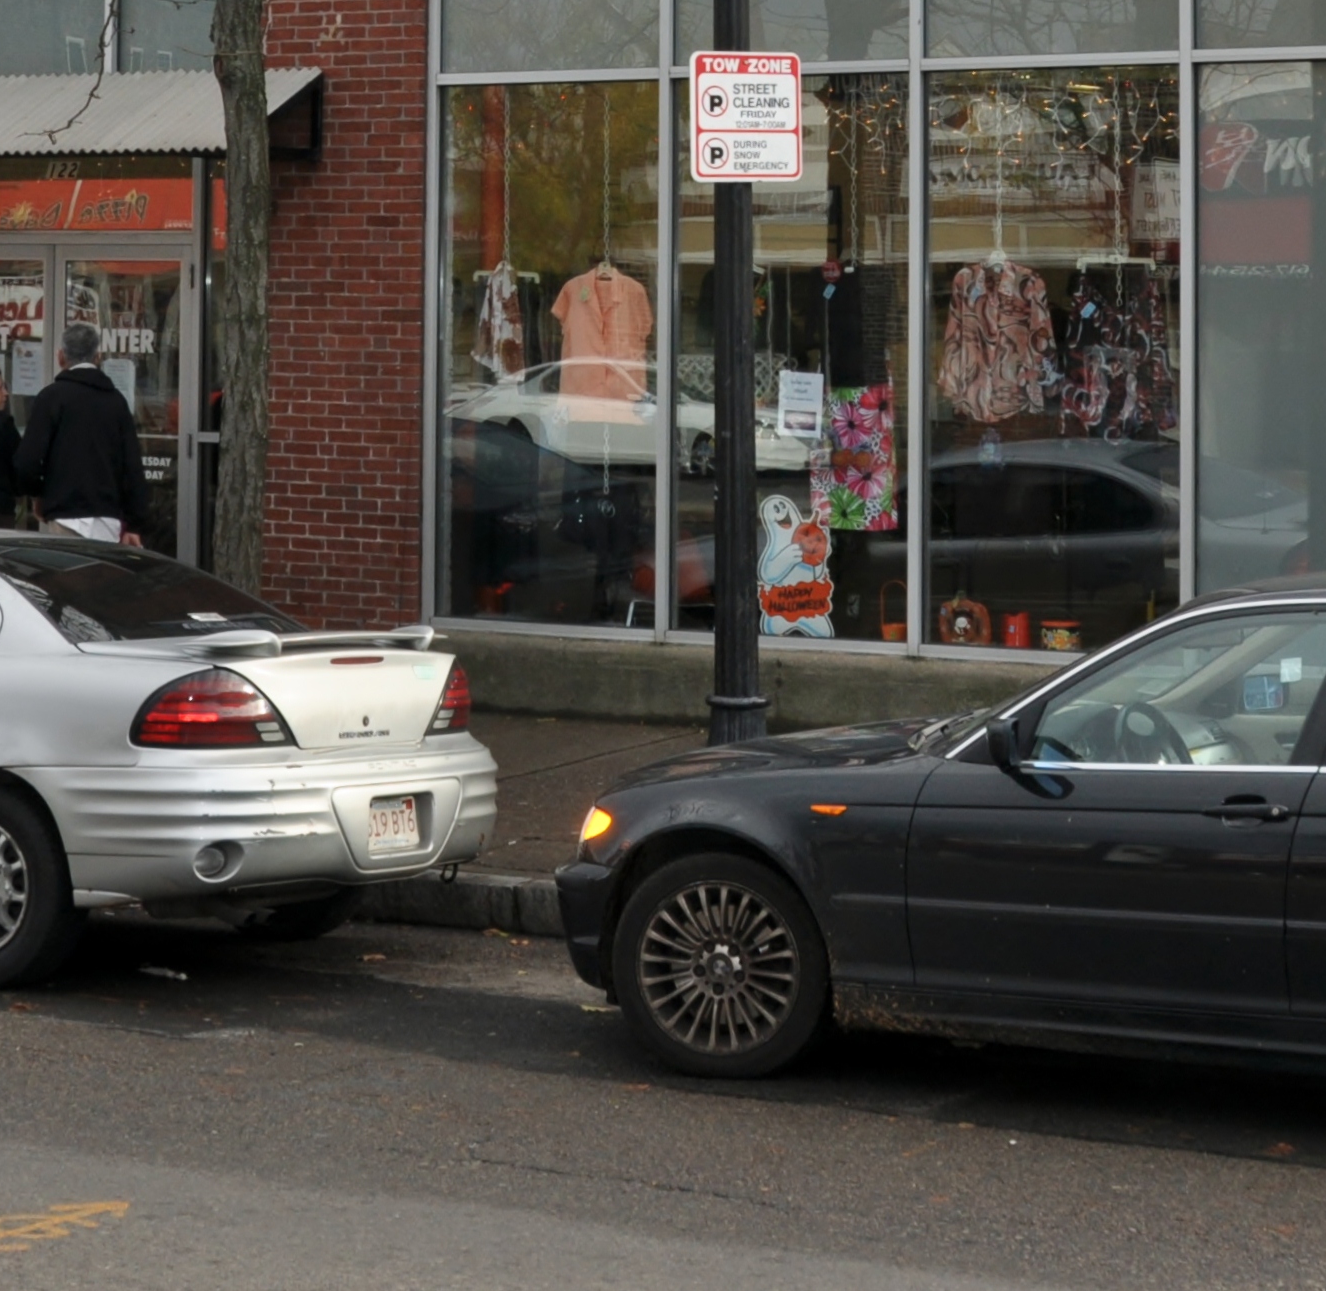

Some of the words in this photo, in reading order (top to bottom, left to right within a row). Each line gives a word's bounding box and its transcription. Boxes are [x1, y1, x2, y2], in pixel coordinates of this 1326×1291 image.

[702, 57, 740, 73] TOW
[746, 58, 792, 74] ZONE
[732, 83, 778, 95] STREET
[732, 97, 790, 109] CLEANING
[740, 110, 777, 119] FRIDAY
[733, 140, 767, 149] DURING
[733, 151, 761, 159] SNOW
[49, 162, 77, 178] 122
[733, 161, 789, 171] EMERGENCY
[101, 328, 155, 353] NTER
[141, 456, 172, 467] ESDAY
[144, 470, 164, 480] DAY
[778, 587, 813, 599] HAPPY
[768, 598, 826, 613] HALLOWEEN
[391, 809, 416, 836] BT6
